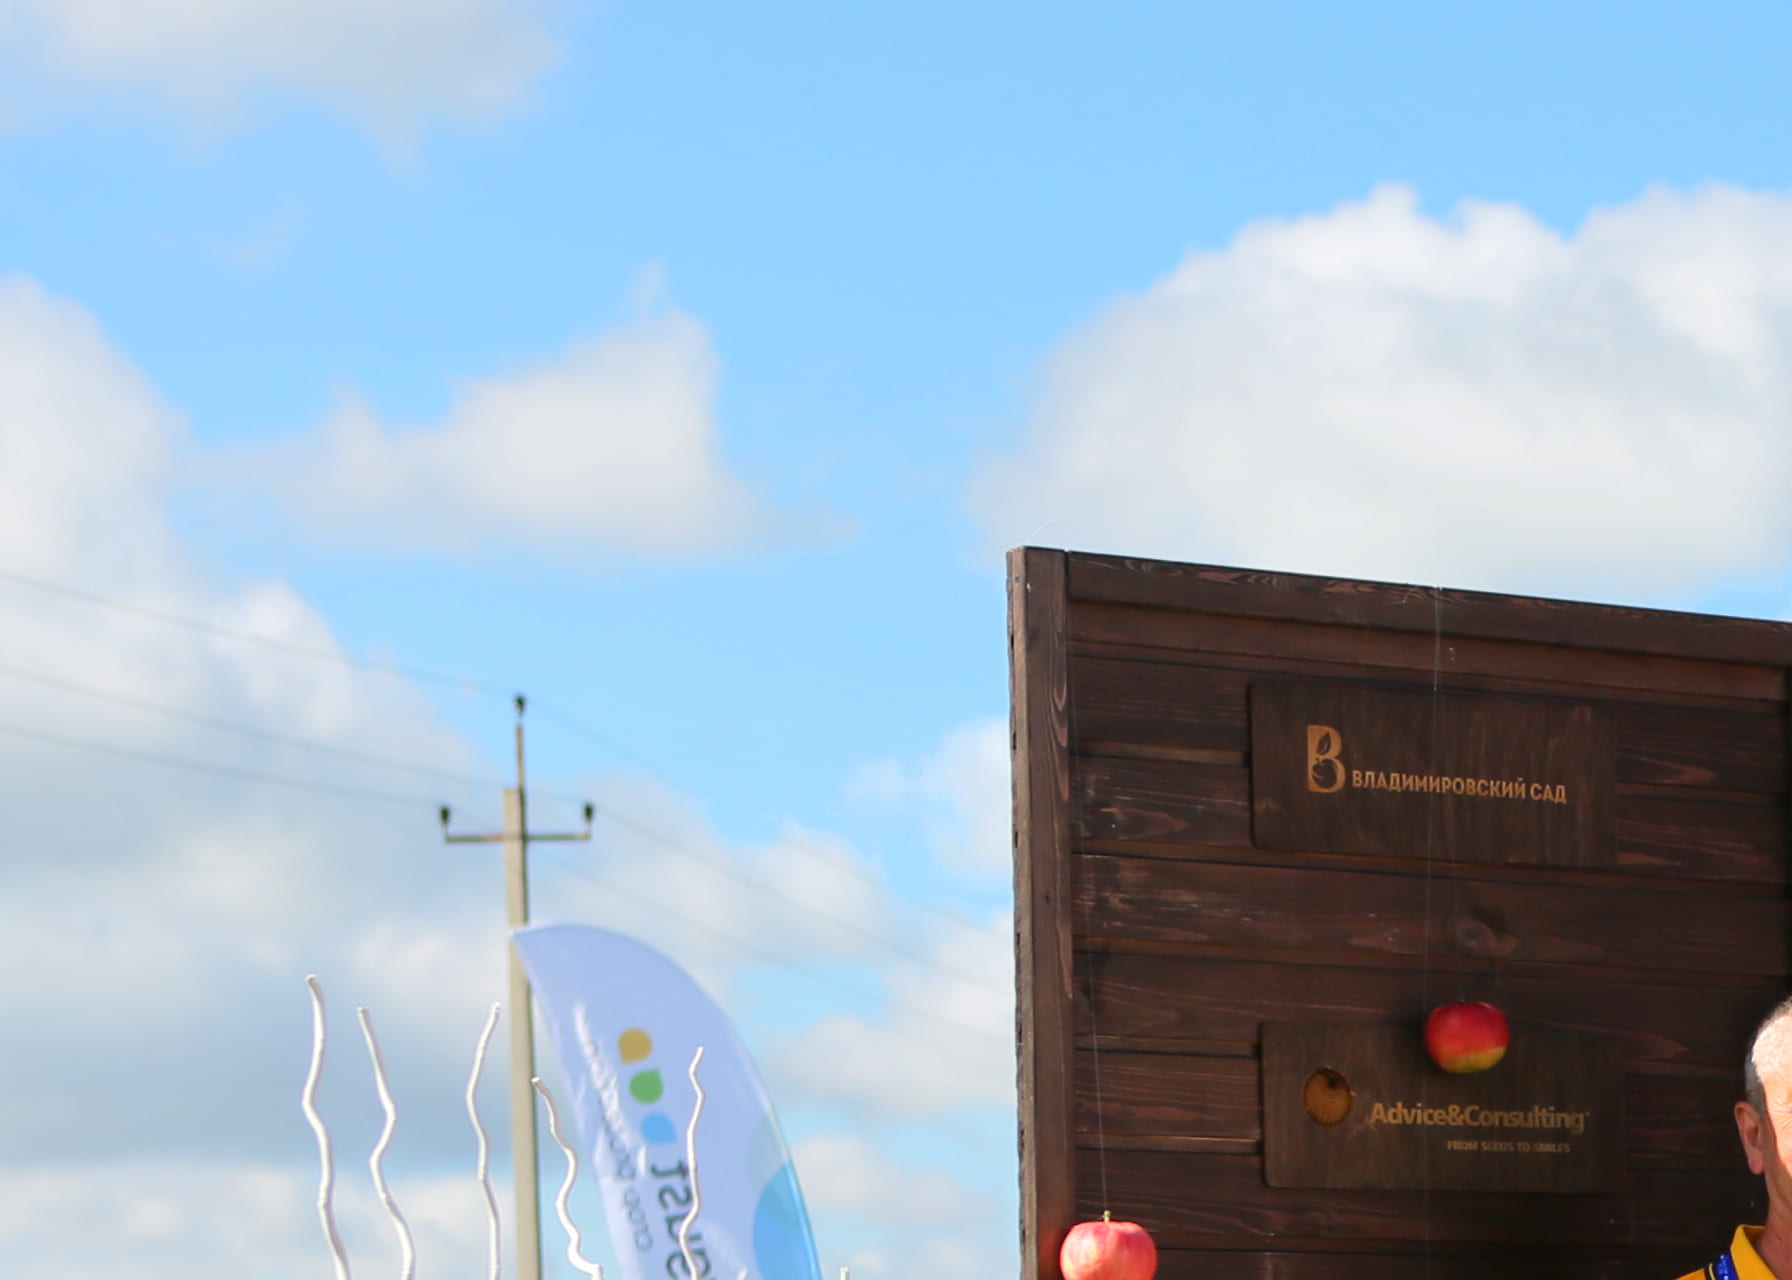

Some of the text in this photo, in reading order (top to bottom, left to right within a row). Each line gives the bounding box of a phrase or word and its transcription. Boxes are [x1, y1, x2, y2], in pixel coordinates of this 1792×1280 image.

[1352, 769, 1526, 799] ВЛАДИМИРОВСКИЙ
[1530, 783, 1567, 804] САД
[1369, 1102, 1584, 1135] Advice&Consulting
[1517, 1142, 1531, 1152] TO
